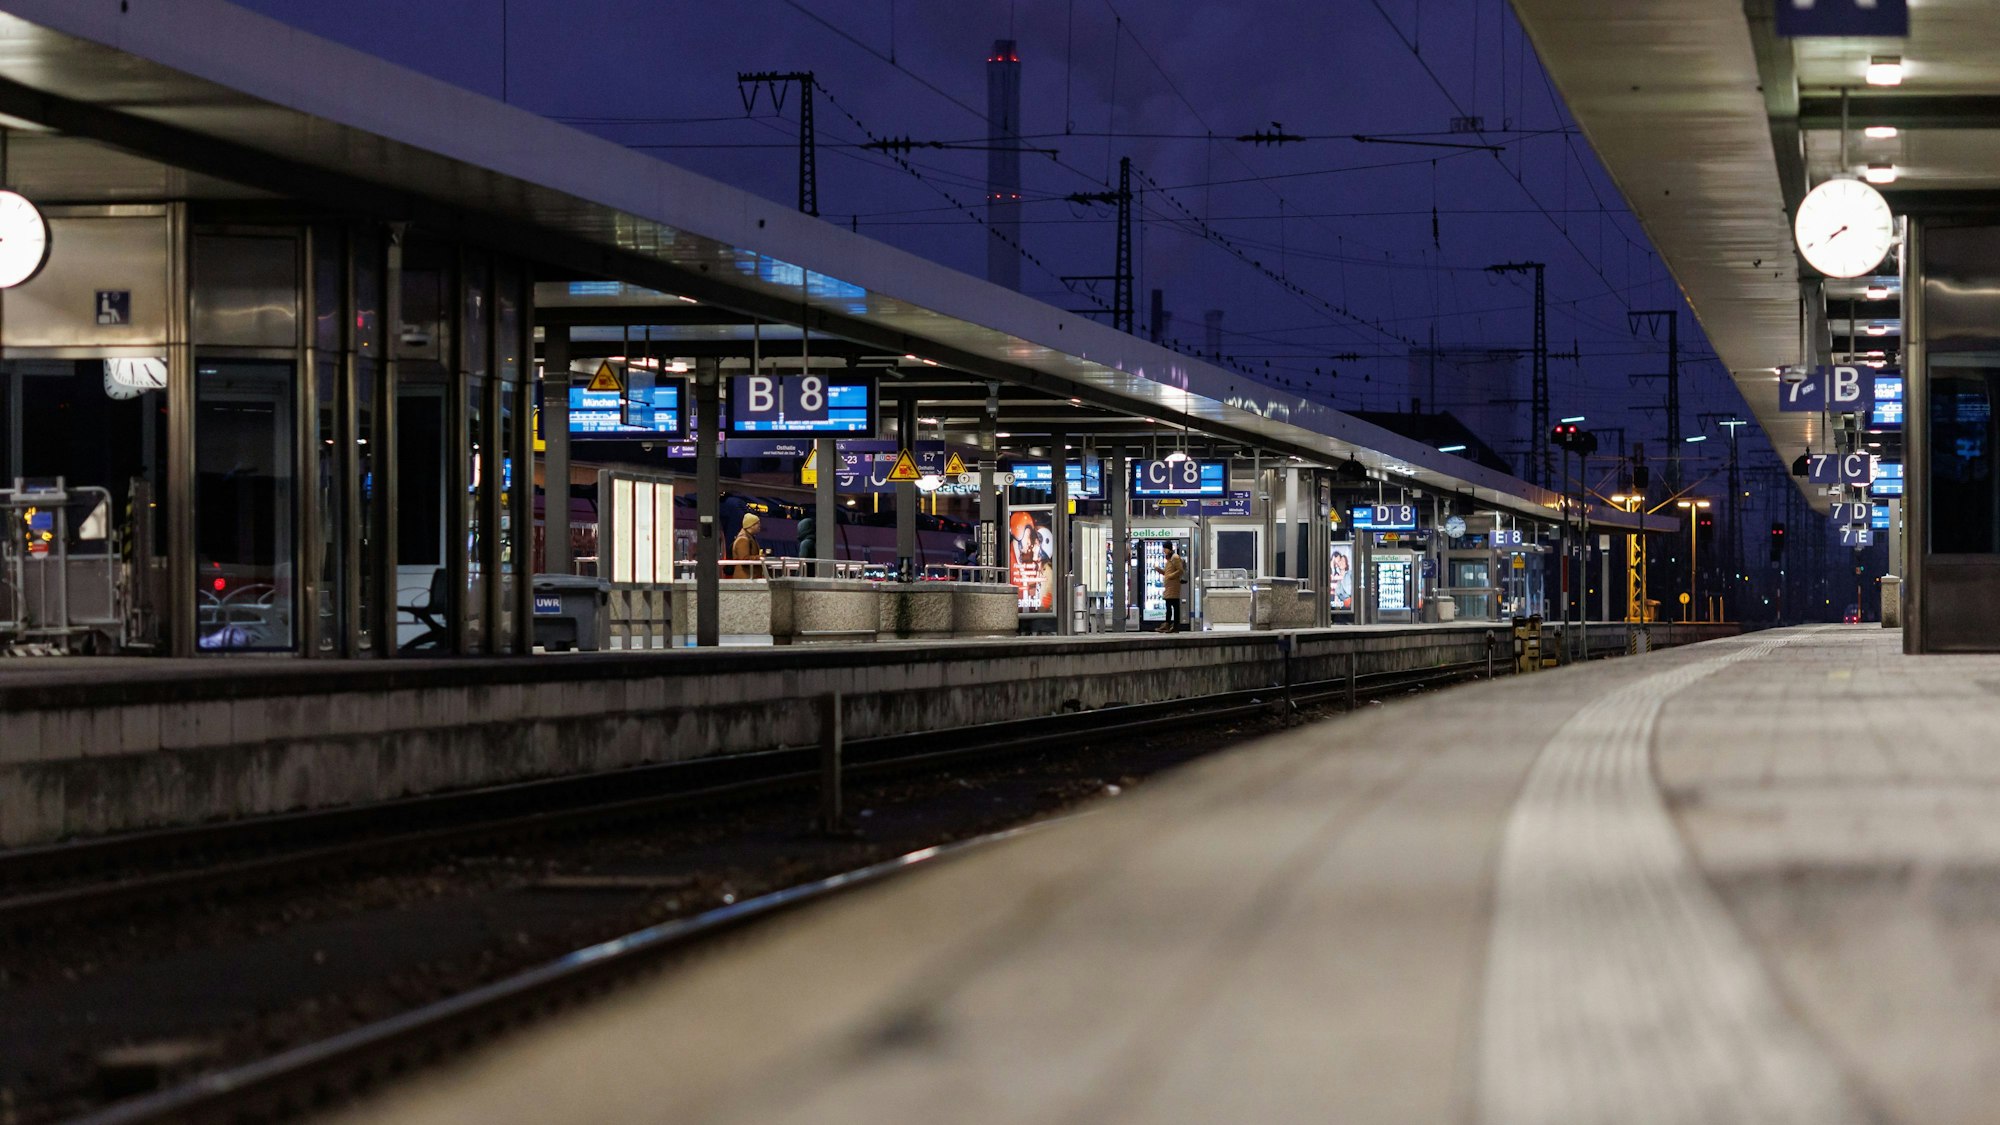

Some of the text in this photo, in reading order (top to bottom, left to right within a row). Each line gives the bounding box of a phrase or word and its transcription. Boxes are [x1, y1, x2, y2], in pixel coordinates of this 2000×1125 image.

[1835, 366, 1860, 402] B
[749, 376, 823, 411] B 8
[1149, 461, 1198, 483] C 8
[1812, 454, 1862, 477] 7 C
[1377, 505, 1389, 521] D
[1400, 505, 1411, 521] 8
[1832, 503, 1843, 519] 7
[1853, 503, 1867, 519] D
[1496, 530, 1521, 543] E 8
[1843, 530, 1867, 543] 7 E
[536, 598, 560, 607] UWR
